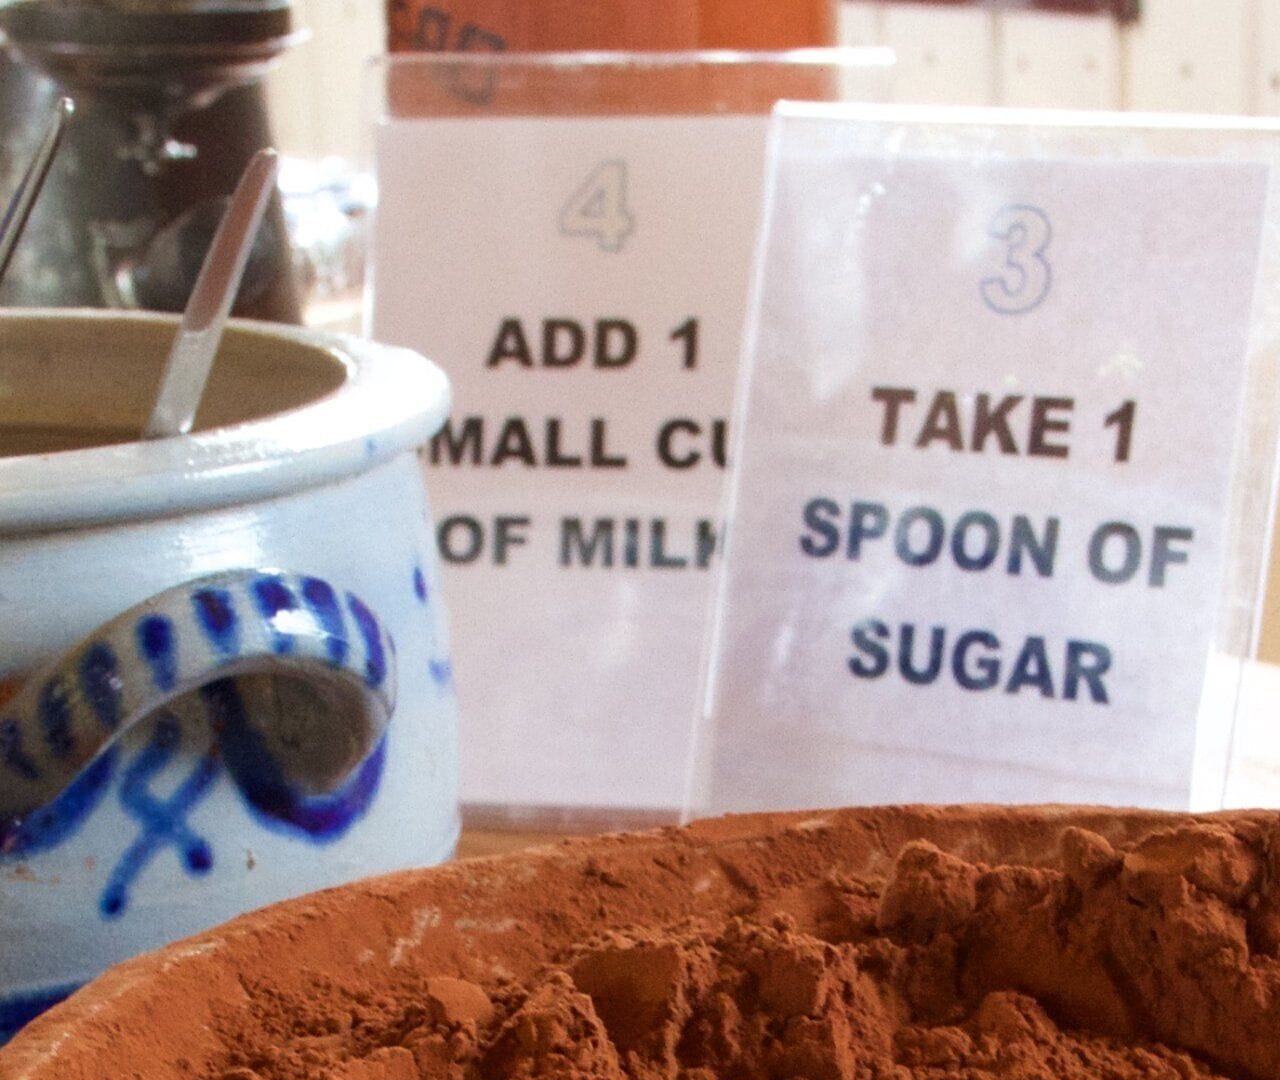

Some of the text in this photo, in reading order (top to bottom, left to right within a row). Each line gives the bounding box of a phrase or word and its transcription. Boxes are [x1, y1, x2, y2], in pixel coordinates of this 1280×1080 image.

[558, 158, 635, 254] 4
[980, 204, 1053, 315] 3
[486, 317, 700, 370] ADD 1
[872, 387, 1137, 462] TAKE 1
[436, 515, 531, 566] OF
[800, 498, 1194, 588] SPOON OF
[848, 619, 1111, 704] SUGAR
